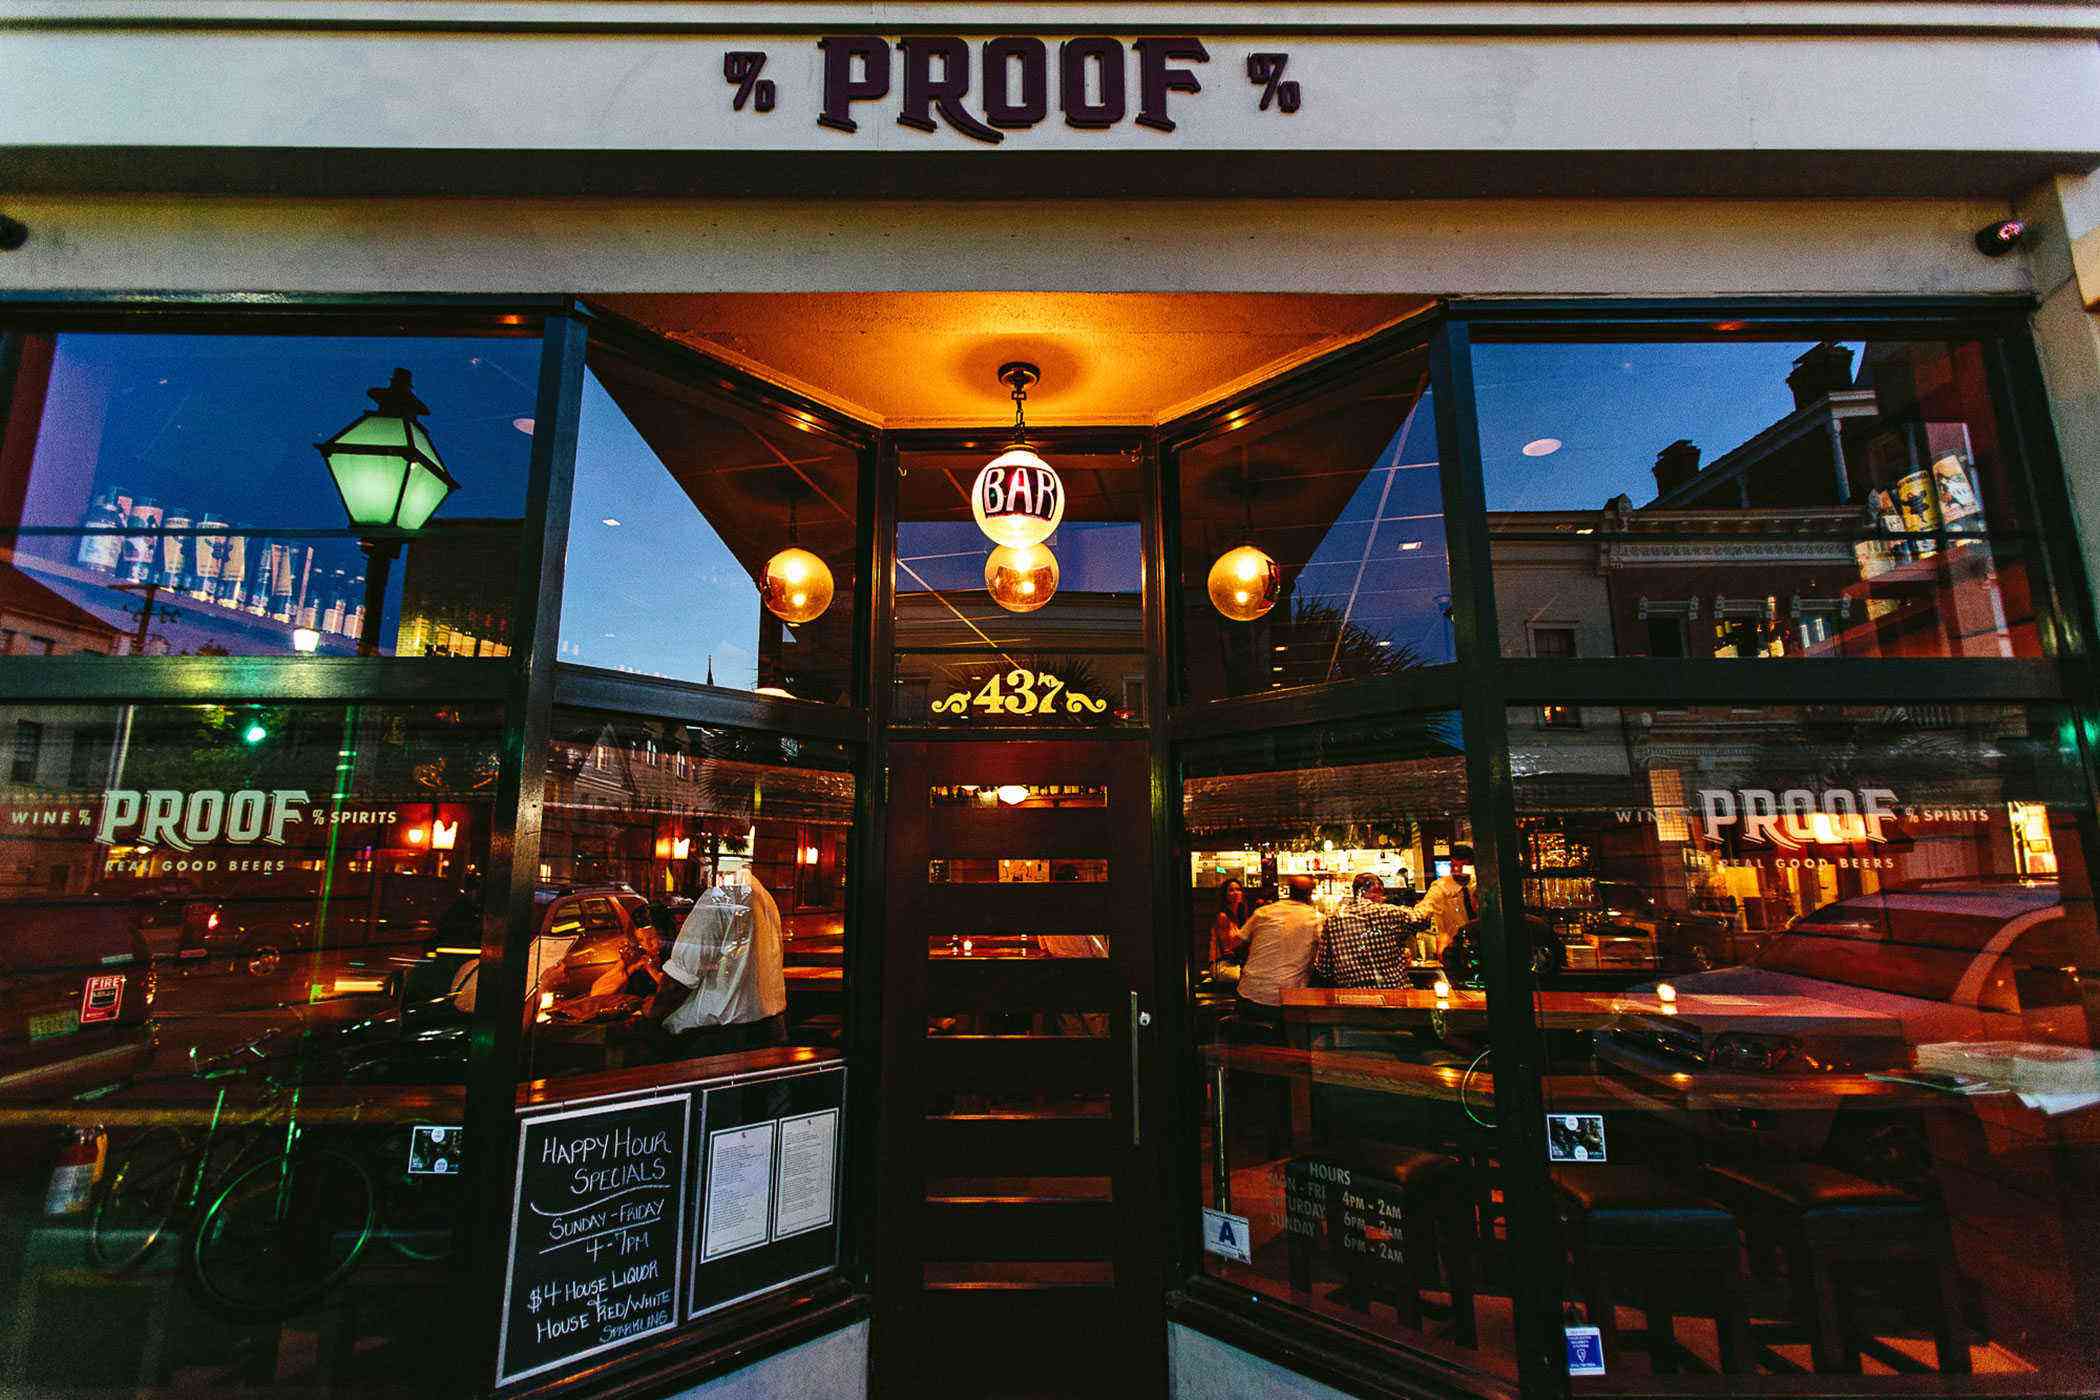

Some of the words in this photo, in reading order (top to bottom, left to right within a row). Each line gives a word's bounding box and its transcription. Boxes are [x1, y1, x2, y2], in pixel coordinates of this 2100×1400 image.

[816, 36, 1210, 144] PROOF
[982, 466, 1058, 520] BAR
[973, 668, 1064, 714] 437
[11, 811, 71, 825] WINE
[95, 789, 310, 852] PROOF
[330, 811, 398, 825] SPIRITS
[1696, 788, 1899, 851] PROOF
[1923, 808, 1990, 823] SPIRITS
[104, 860, 149, 873] REAL
[162, 859, 217, 873] GOOD
[228, 859, 285, 873] BEERS
[1775, 857, 1828, 870] GOOD
[1839, 857, 1895, 870] BEERS
[542, 1133, 610, 1165] HAPPY
[613, 1127, 672, 1161] HOUR
[570, 1158, 666, 1194] SPECIALS
[1309, 1162, 1351, 1186] HOURS
[1307, 1182, 1326, 1200] FRI
[1342, 1190, 1365, 1210] 4PM
[1378, 1198, 1402, 1219] 2AM
[1218, 1220, 1238, 1247] A
[1343, 1211, 1366, 1232] 6PM
[1343, 1231, 1367, 1255] 6PM
[1379, 1242, 1404, 1264] 2AM
[565, 1279, 609, 1304] HOUSE
[611, 1259, 659, 1290] LIQUOR
[536, 1311, 591, 1344] HOUSE
